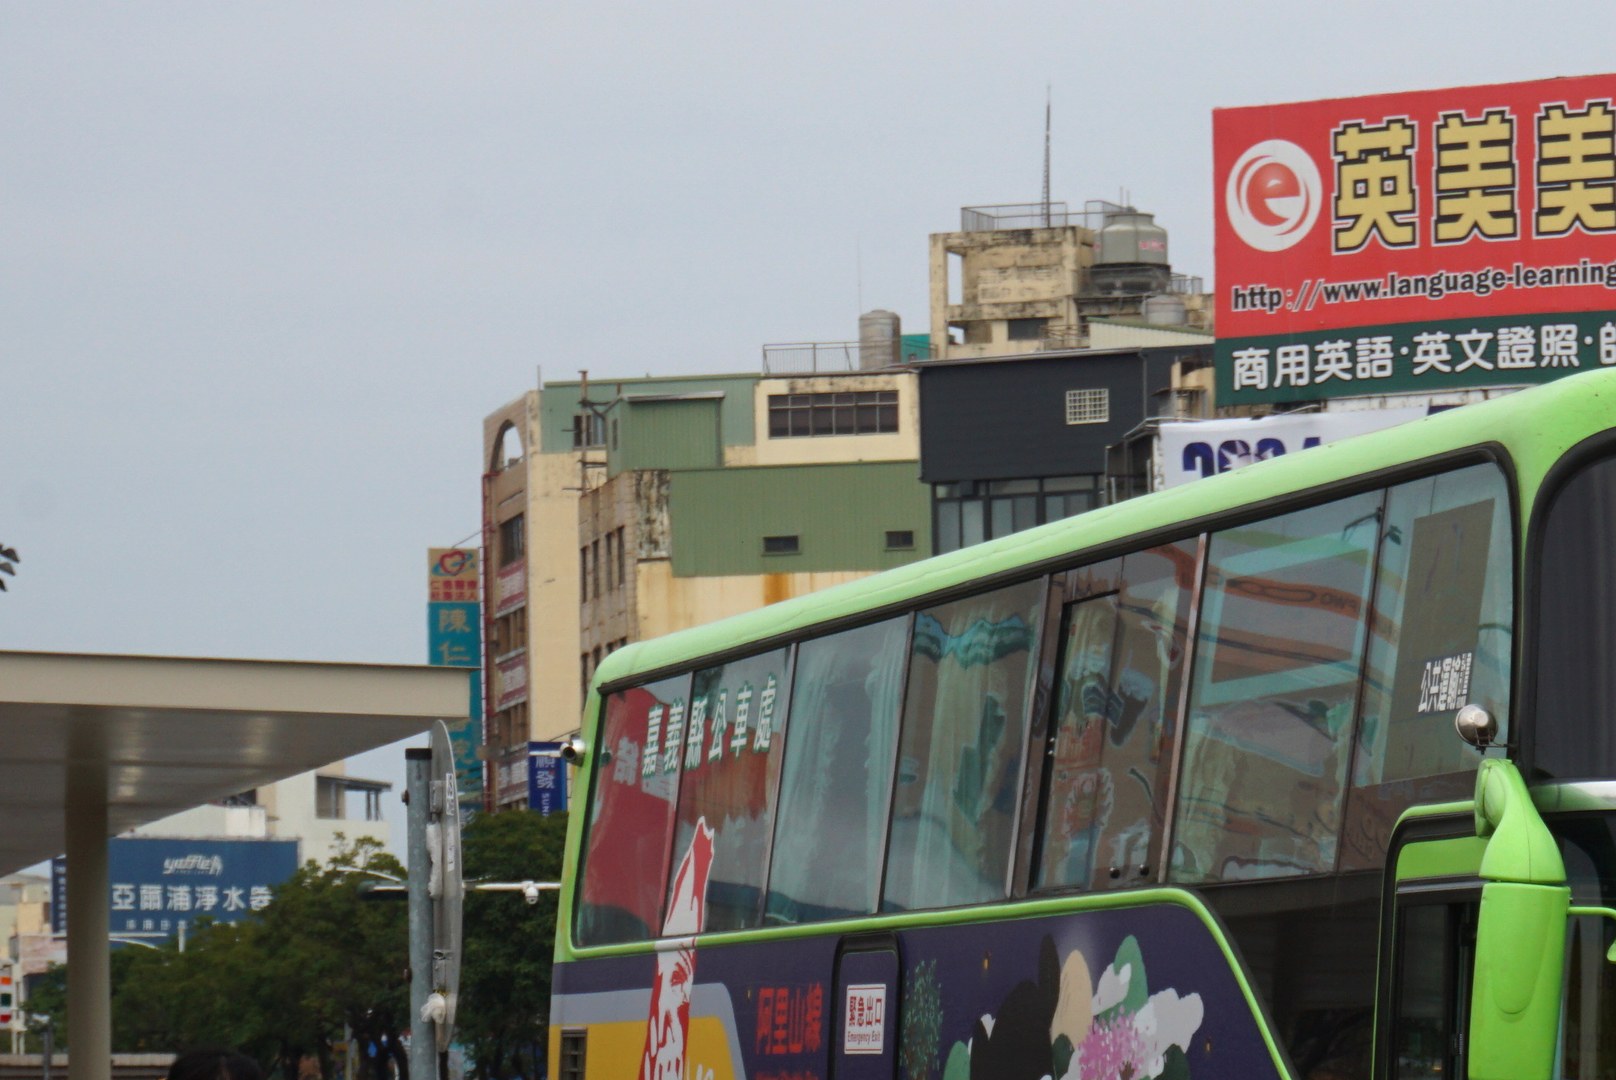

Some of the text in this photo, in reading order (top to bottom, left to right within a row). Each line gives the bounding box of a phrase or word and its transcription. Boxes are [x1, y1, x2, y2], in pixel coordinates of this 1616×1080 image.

[642, 673, 777, 777] 嘉義縣公車處
[755, 981, 823, 1055] 阿里山線
[847, 1030, 881, 1045] Emergency Exit
[848, 995, 882, 1028] 緊急出口
